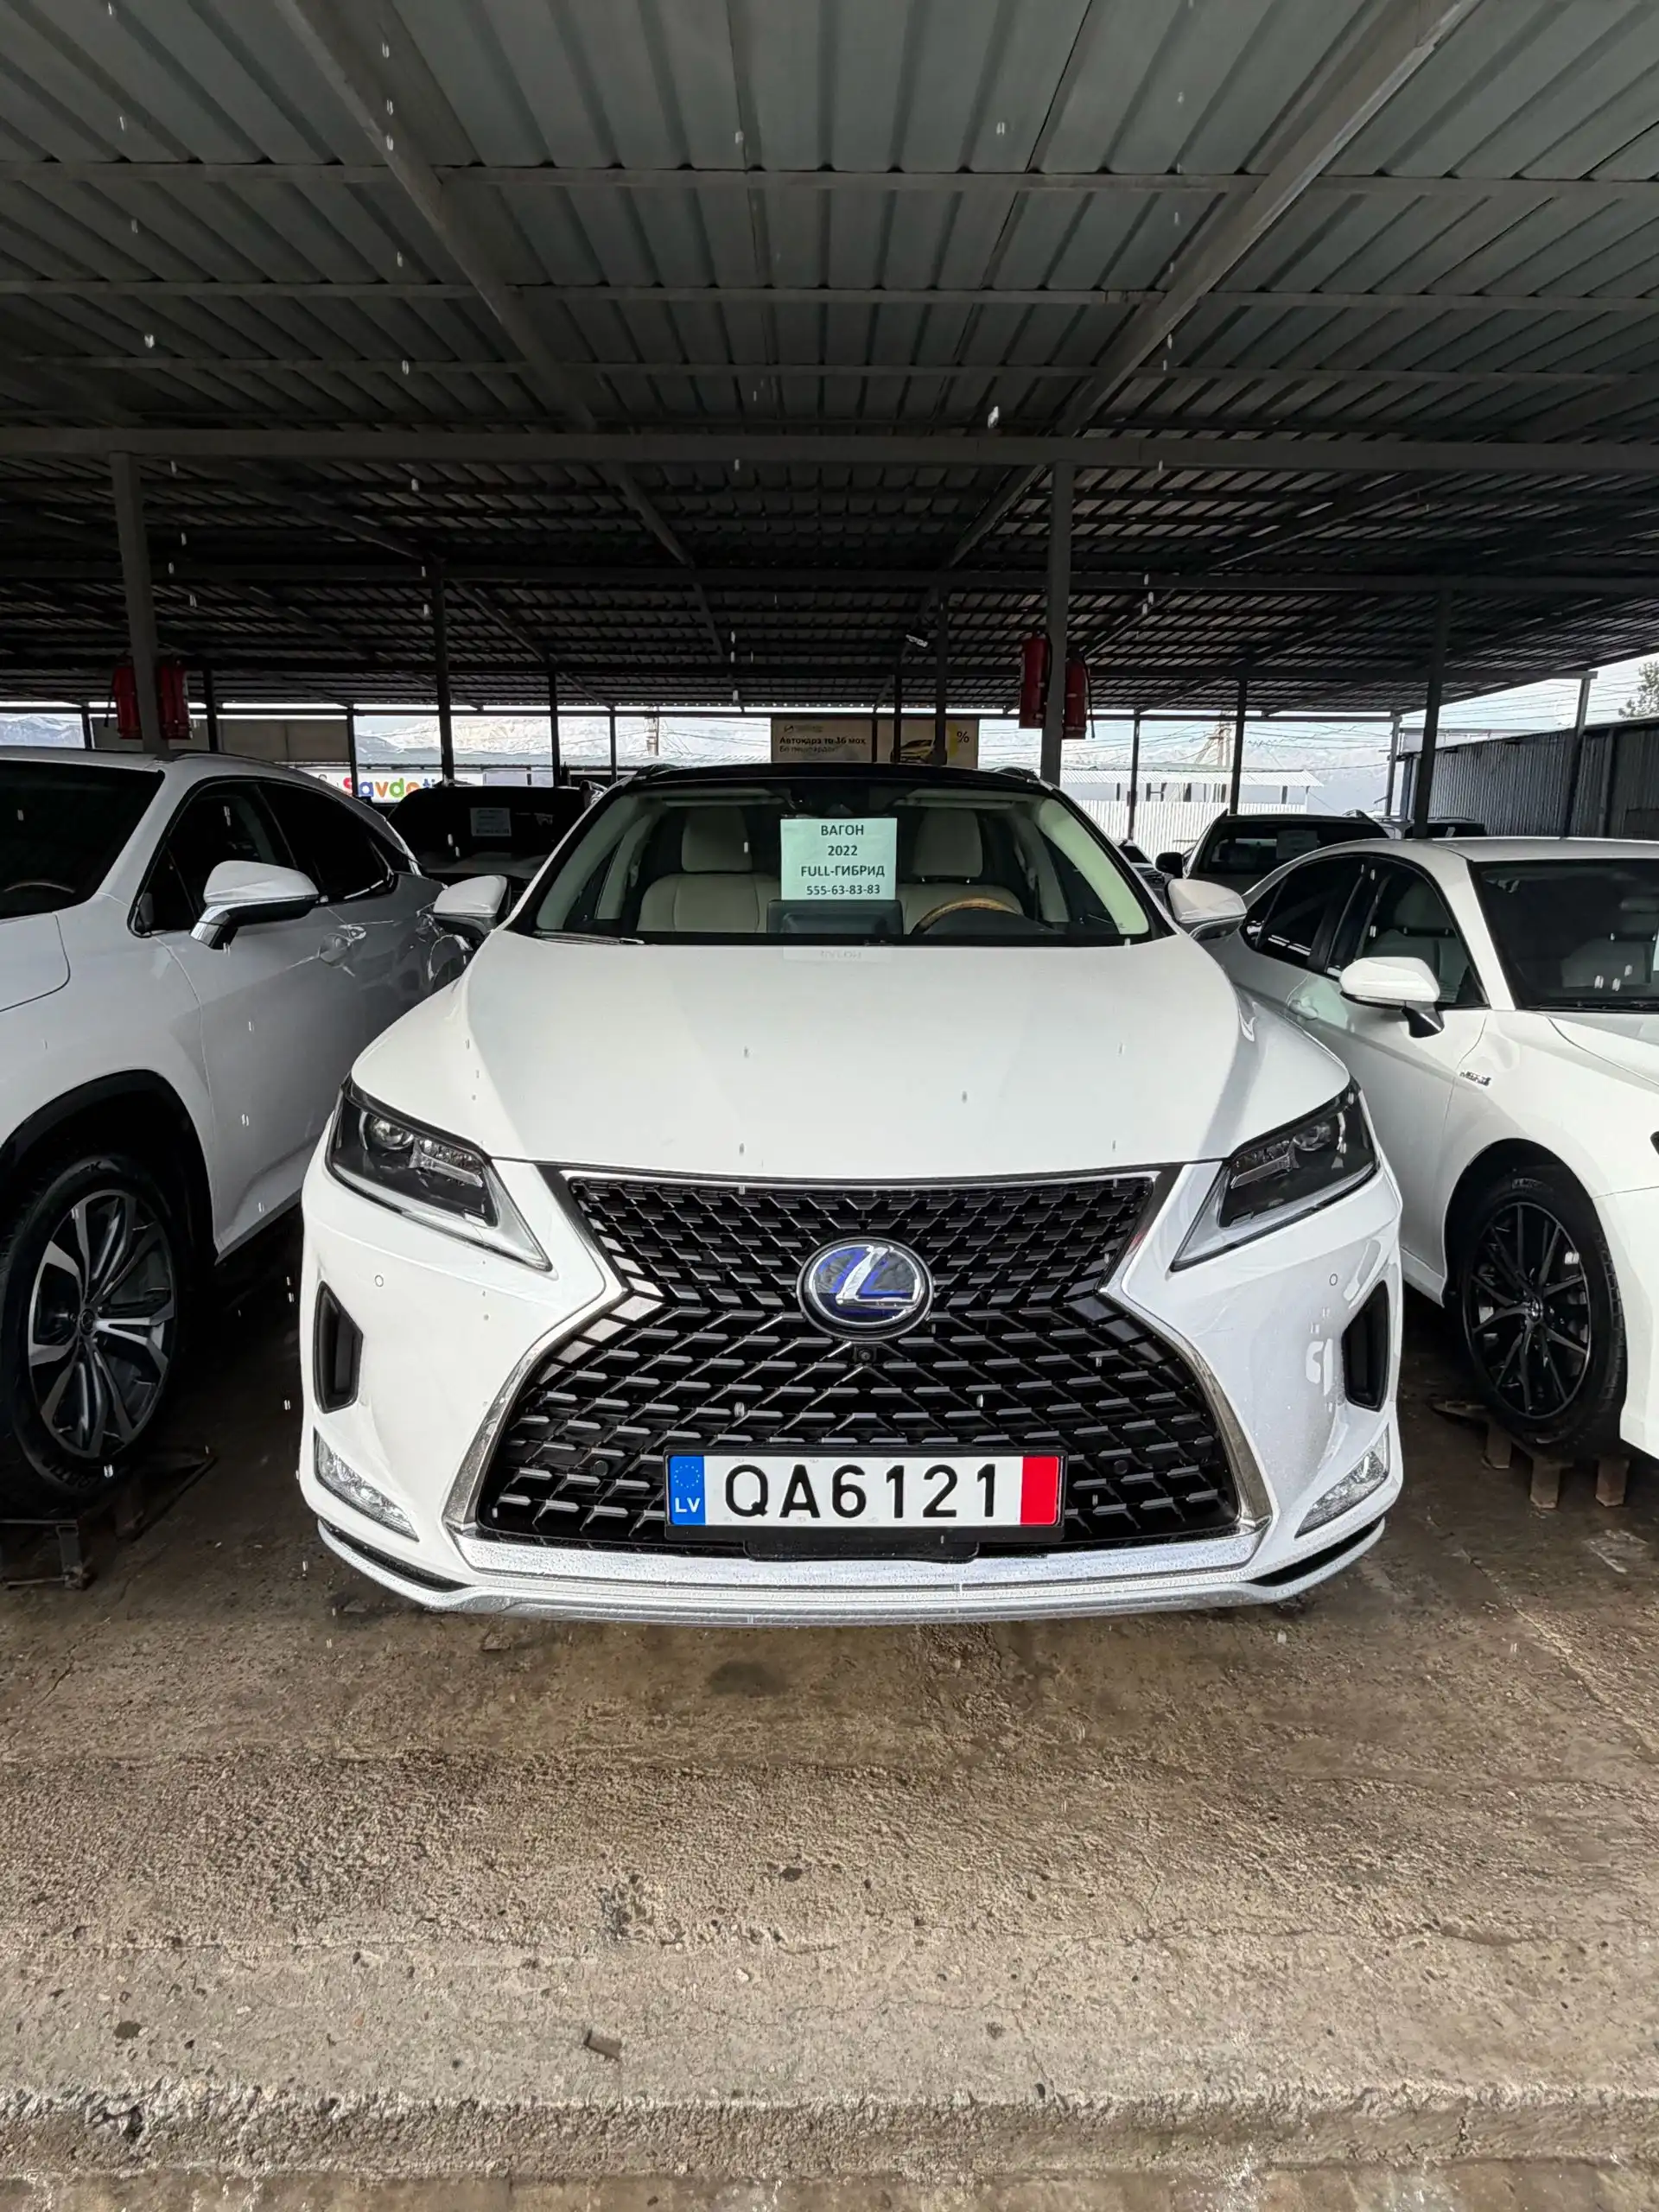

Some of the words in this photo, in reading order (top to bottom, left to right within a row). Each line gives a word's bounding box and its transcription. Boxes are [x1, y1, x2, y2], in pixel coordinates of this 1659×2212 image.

[821, 824, 864, 836] ВАГОН
[828, 845, 858, 856] 2022
[801, 865, 886, 877] FULL-ГИБРИД
[806, 884, 880, 895] 555-63-83-83
[724, 1463, 996, 1518] QA6121
[674, 1497, 701, 1513] LV
